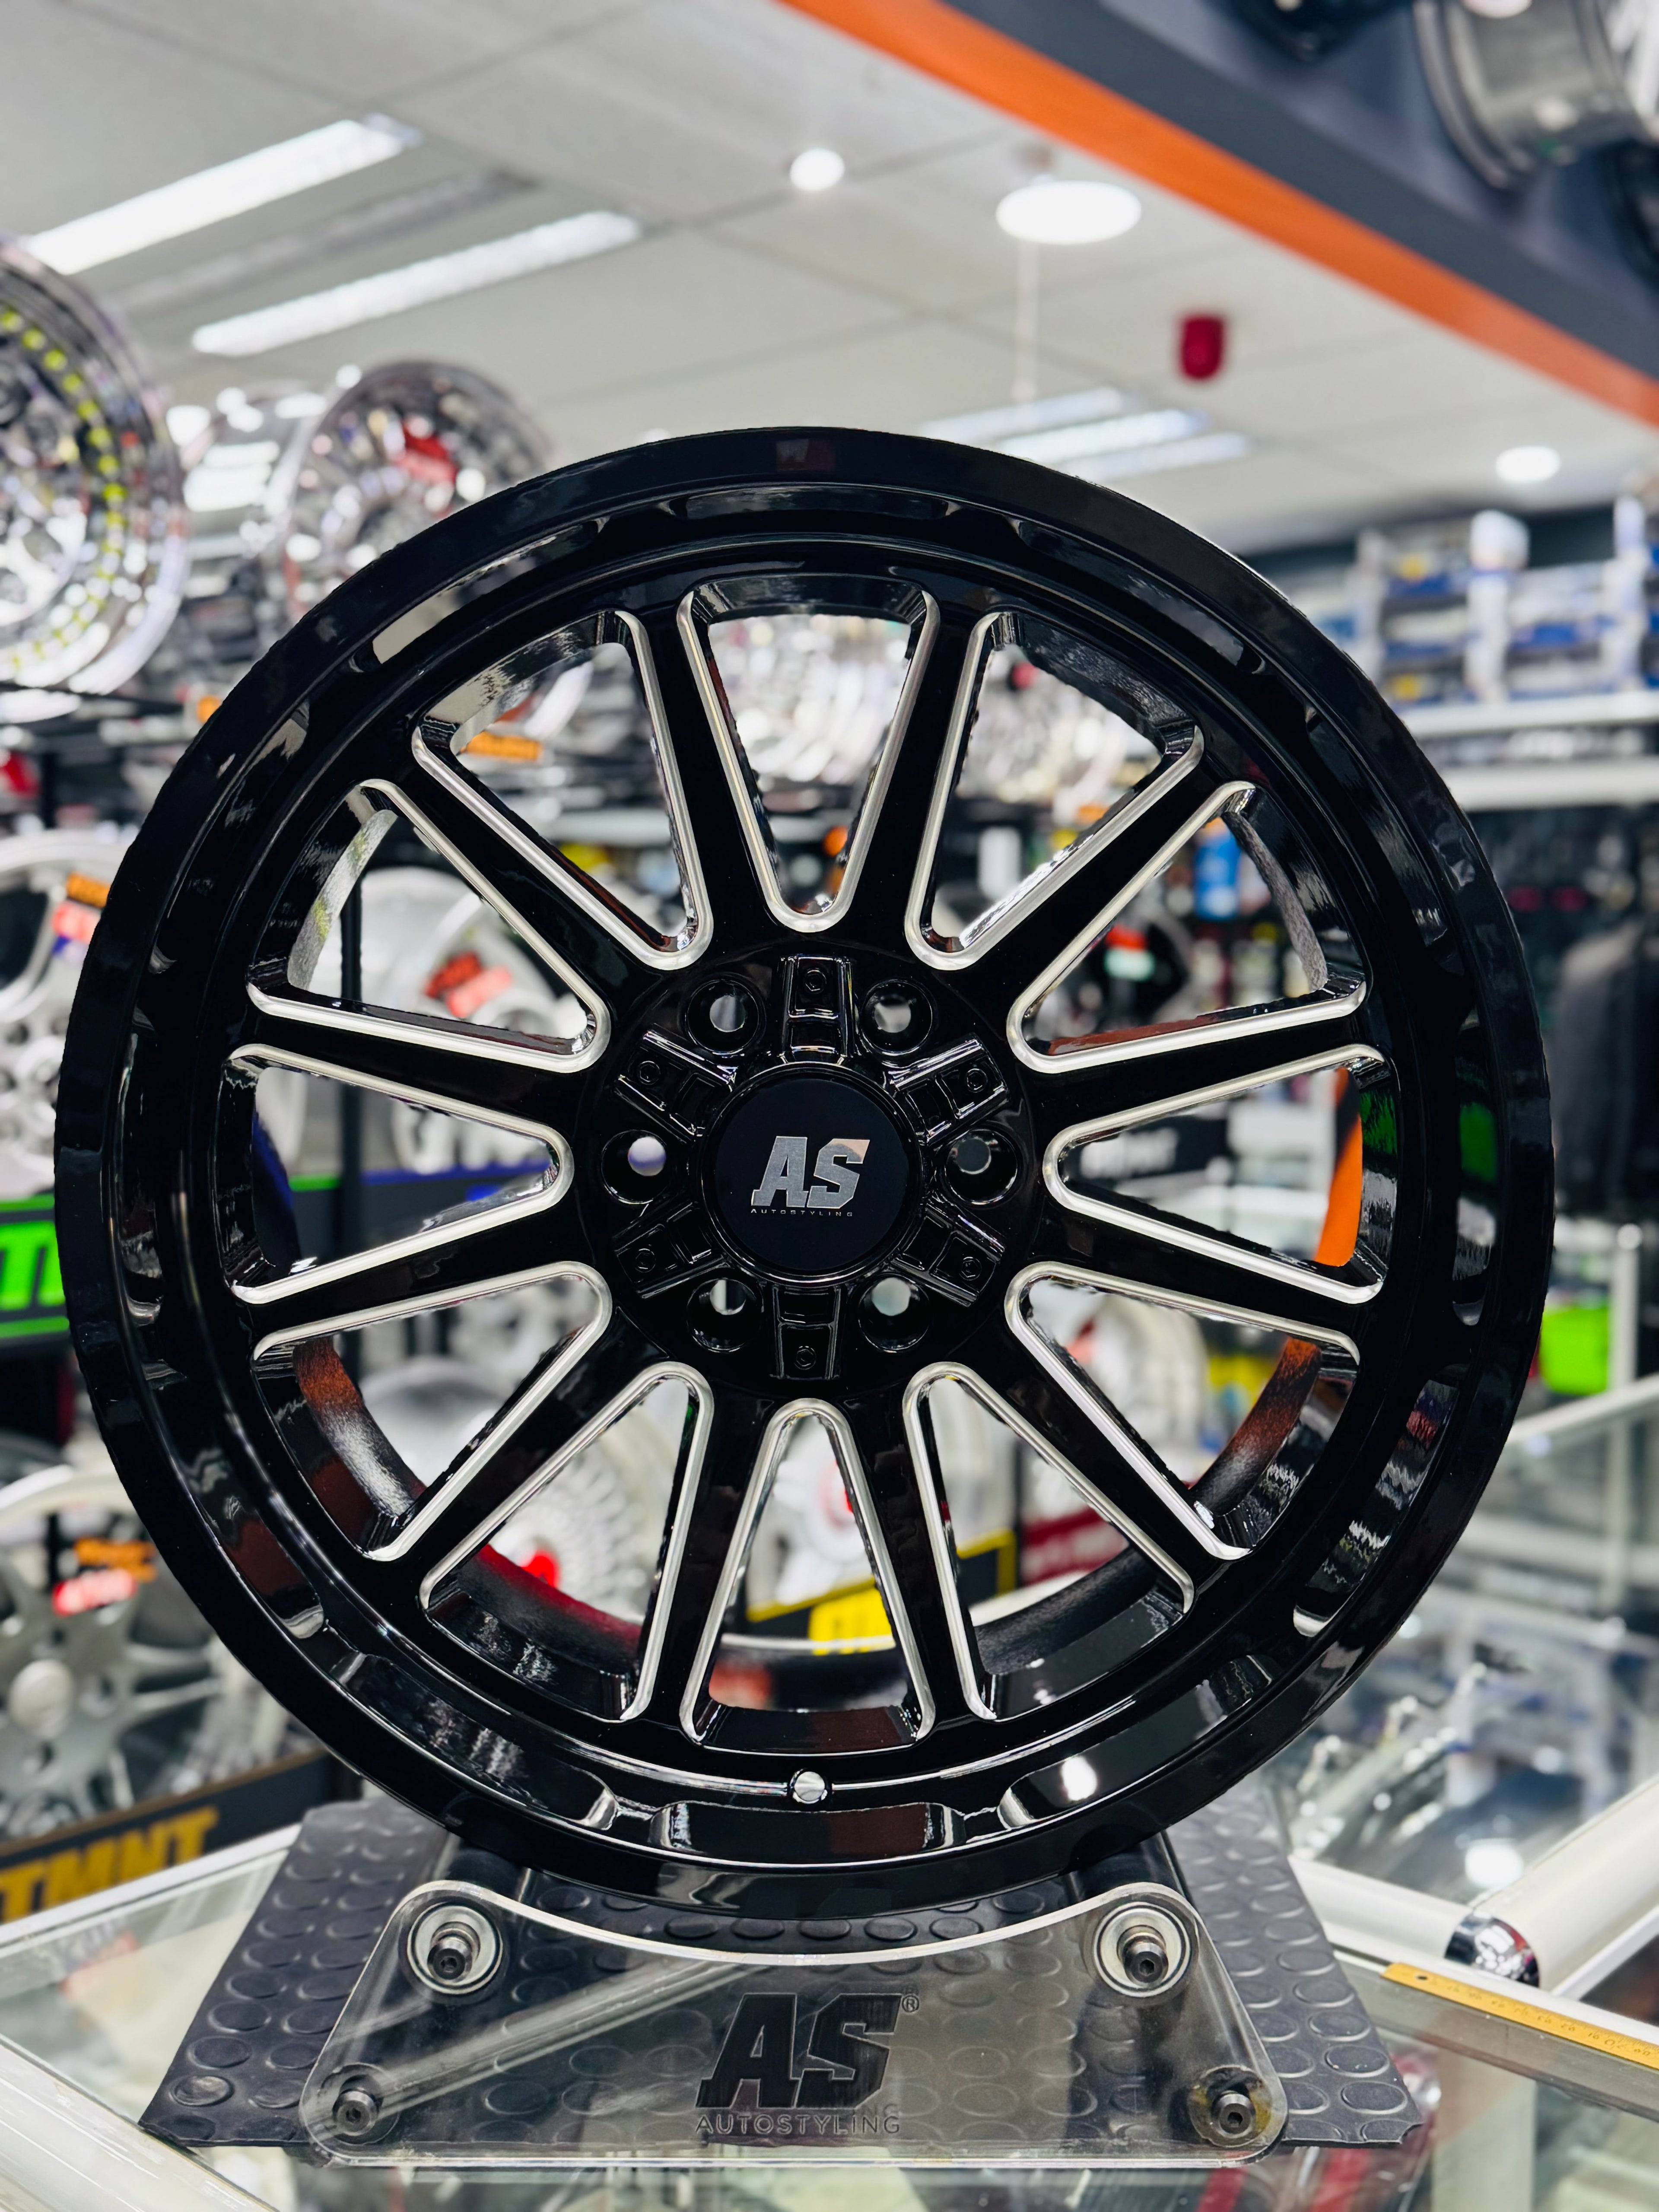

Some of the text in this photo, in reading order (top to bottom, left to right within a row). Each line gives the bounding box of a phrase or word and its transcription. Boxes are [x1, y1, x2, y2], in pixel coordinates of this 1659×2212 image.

[751, 1136, 870, 1209] AS
[695, 1993, 902, 2110] AS
[696, 2114, 899, 2134] AUTOSTYLING
